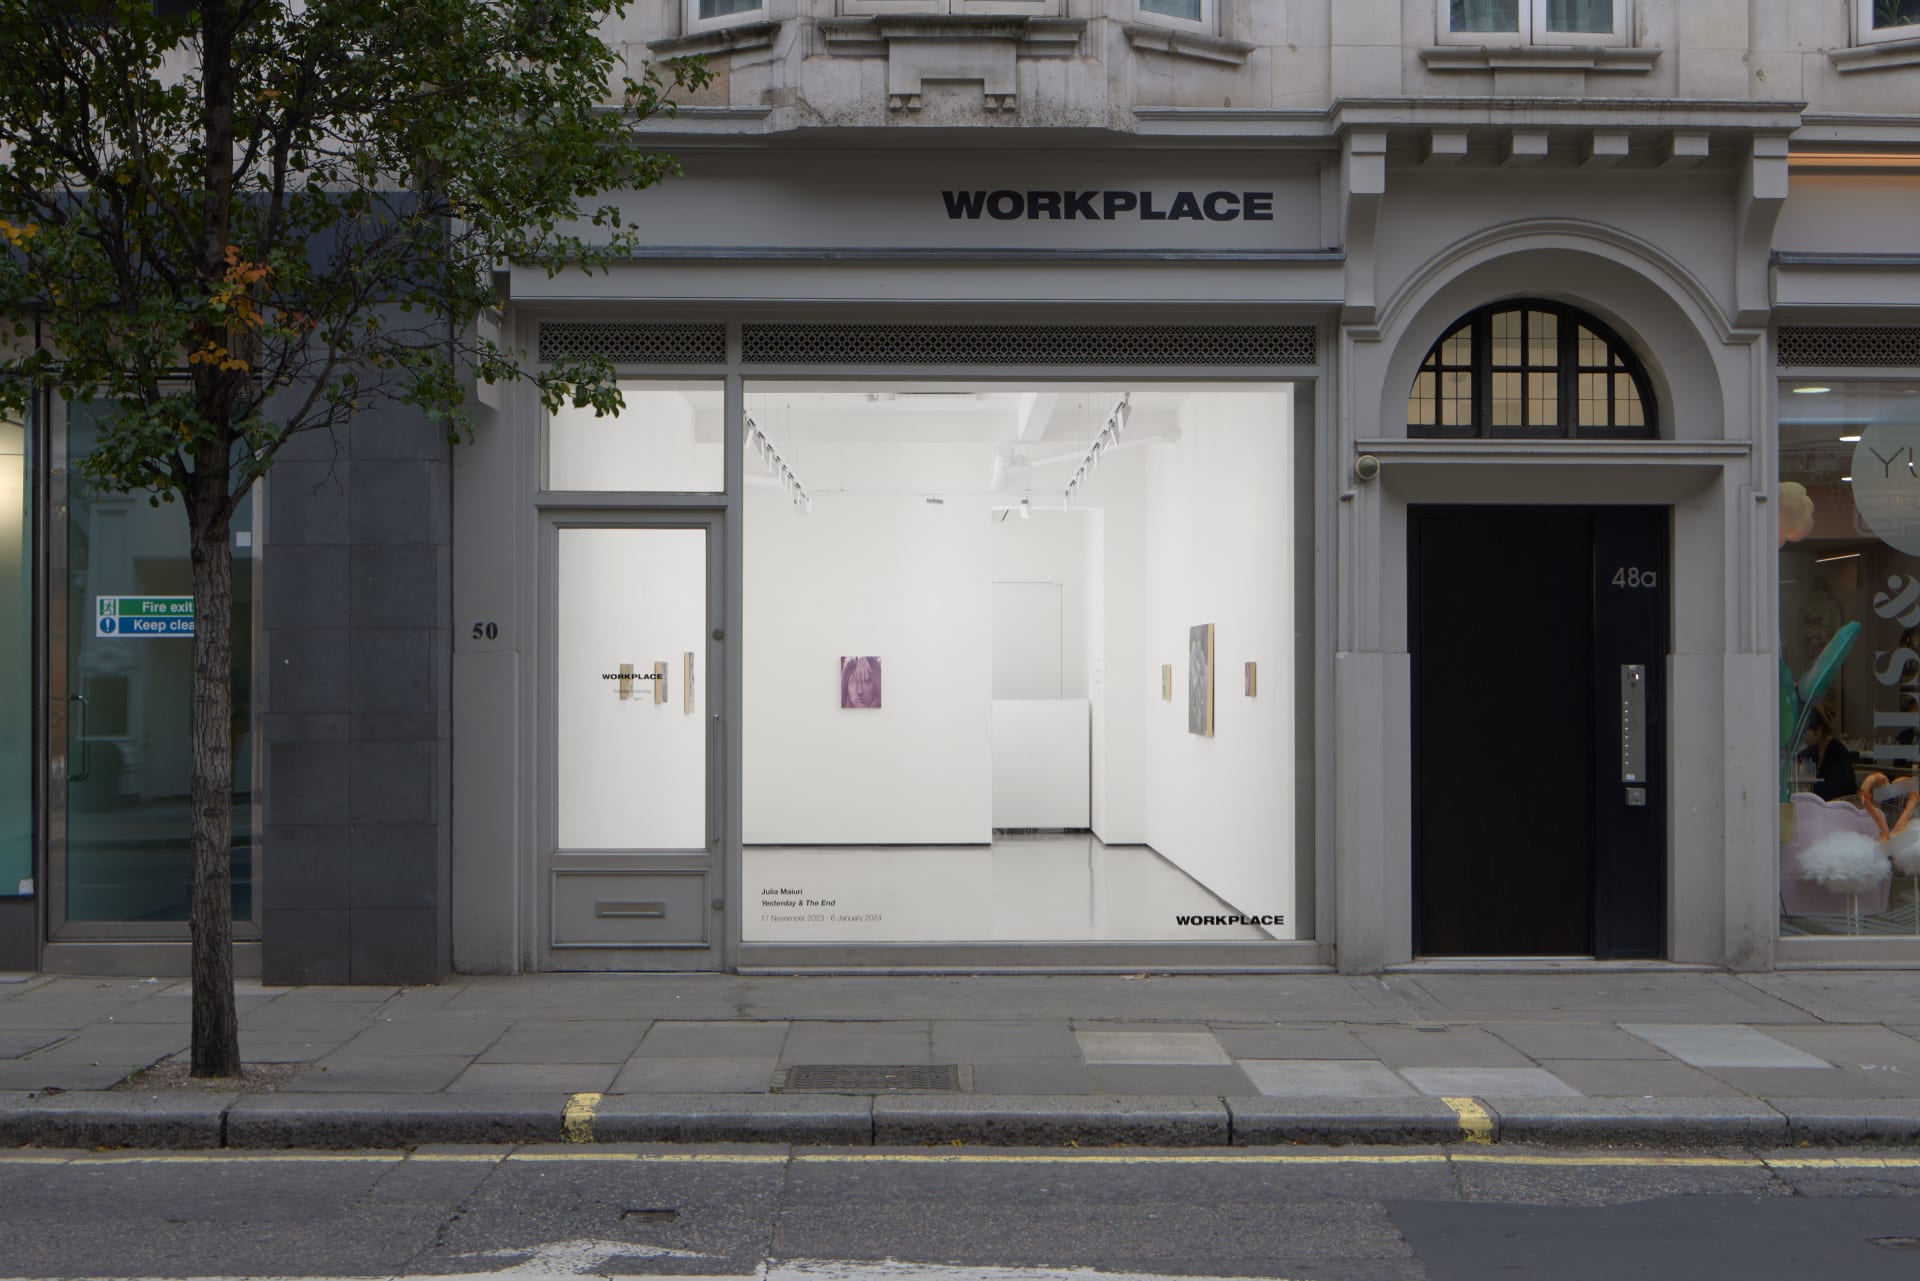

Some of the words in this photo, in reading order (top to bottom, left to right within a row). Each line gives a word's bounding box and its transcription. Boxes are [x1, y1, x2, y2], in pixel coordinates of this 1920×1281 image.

[941, 189, 1274, 222] WORKPLACE
[1611, 567, 1657, 588] 48a
[142, 601, 167, 613] Fire
[170, 601, 193, 613] exit
[1872, 574, 1920, 629] &
[133, 619, 166, 633] Keep
[169, 619, 195, 631] clea
[472, 622, 498, 640] 50
[761, 888, 779, 896] Julia
[780, 888, 803, 896] Maiuri
[761, 899, 797, 908] Yesterday
[805, 899, 820, 907] The
[820, 899, 836, 907] End
[761, 914, 769, 922] 17
[770, 914, 805, 922] November
[807, 914, 825, 922] 2023
[830, 914, 836, 922] 6
[837, 914, 863, 923] January
[864, 914, 882, 922] 2024
[1176, 915, 1284, 926] WORKPLACE
